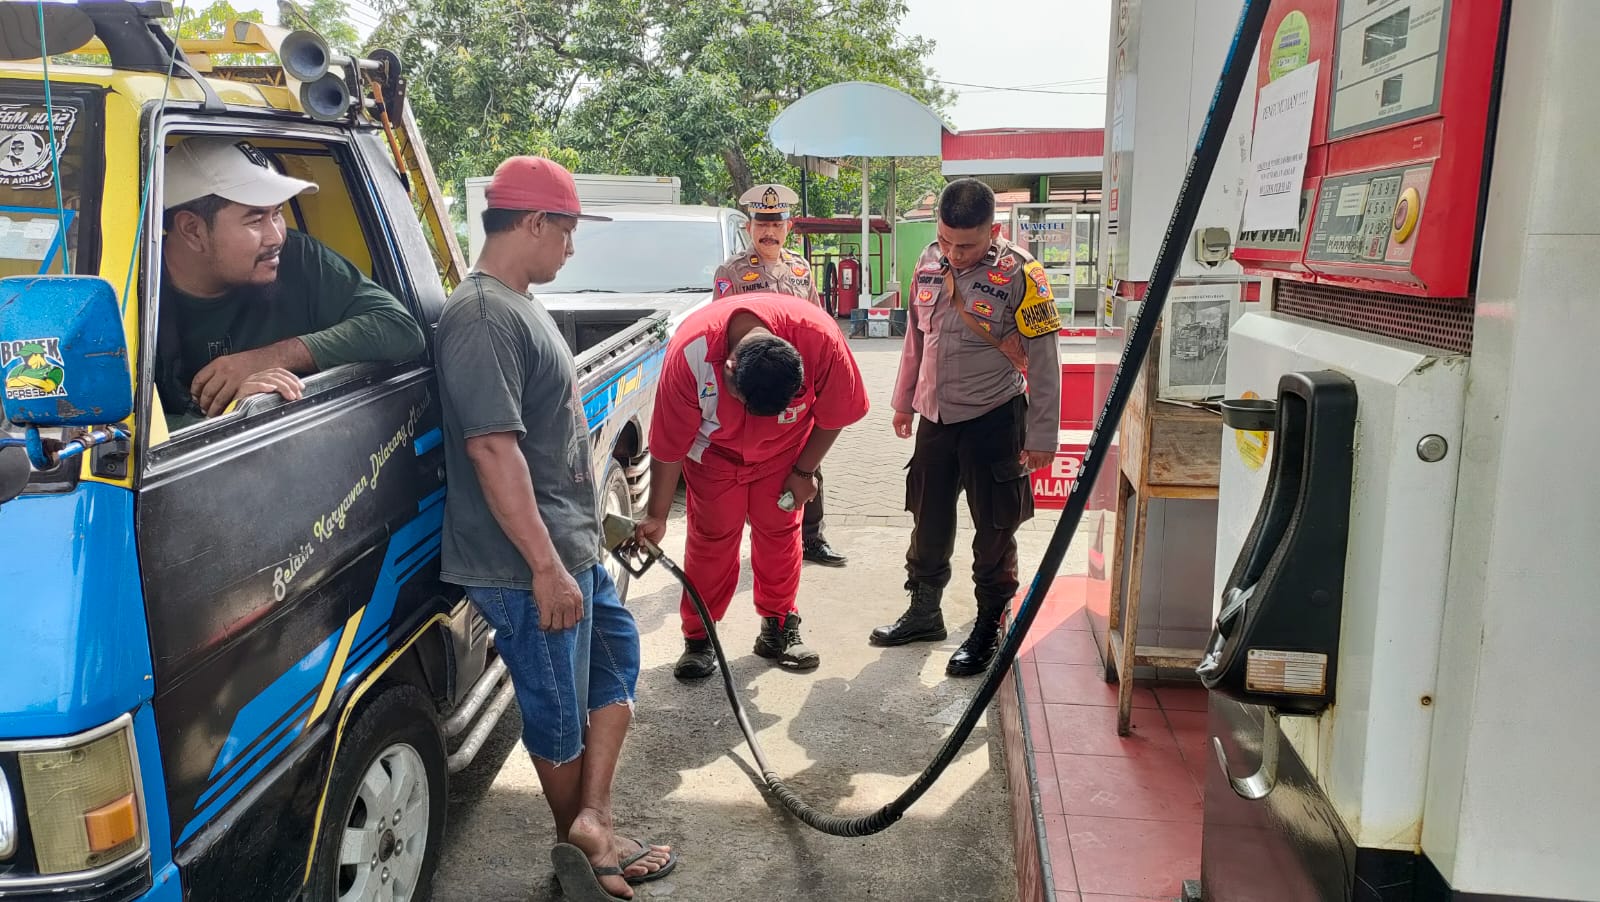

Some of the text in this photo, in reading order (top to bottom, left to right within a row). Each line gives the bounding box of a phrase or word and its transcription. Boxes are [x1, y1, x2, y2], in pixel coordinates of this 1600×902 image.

[12, 171, 49, 184] ARIANA
[972, 281, 1009, 301] POLRI
[272, 541, 315, 602] Selain
[313, 474, 368, 543] Karyawan
[369, 423, 407, 490] Dilarang
